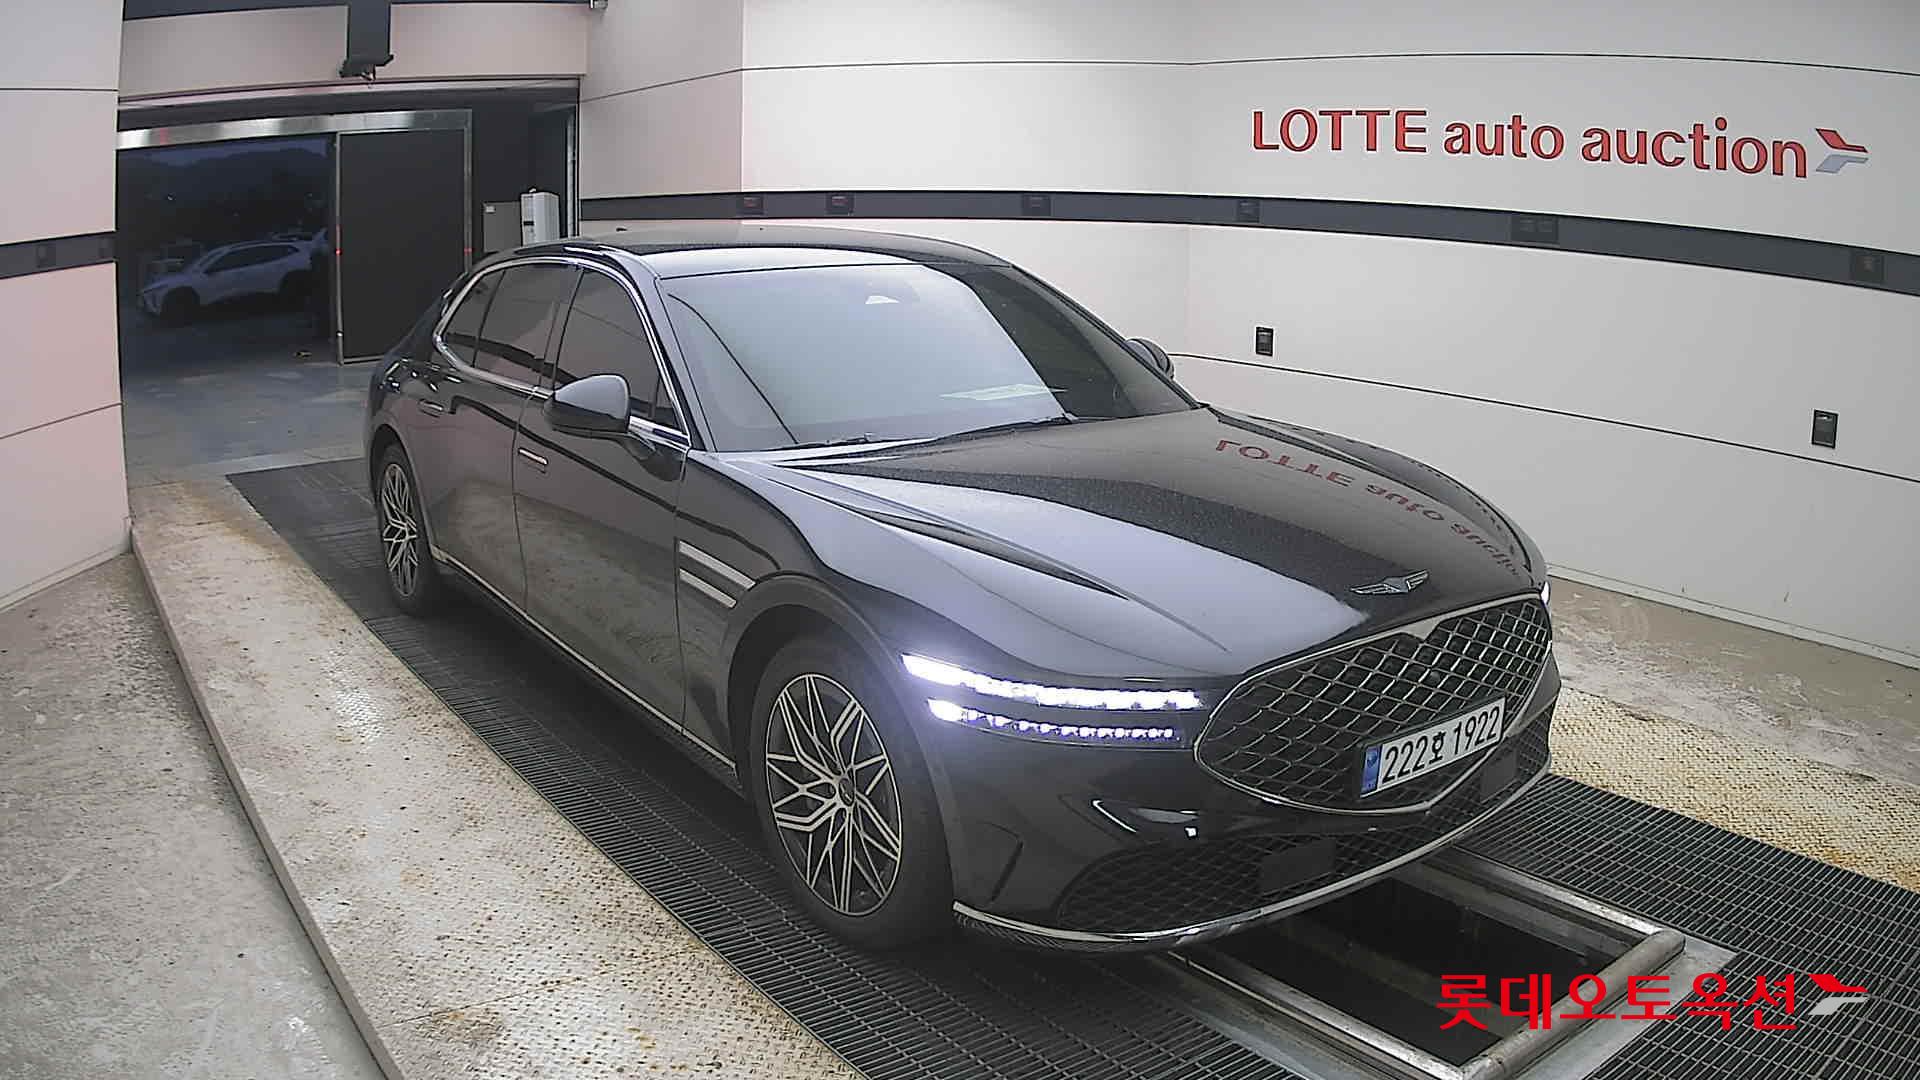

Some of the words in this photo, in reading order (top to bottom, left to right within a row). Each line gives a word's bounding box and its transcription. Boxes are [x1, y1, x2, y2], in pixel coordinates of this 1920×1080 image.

[1252, 109, 1427, 153] LOTTE
[1443, 115, 1565, 159] auto
[1580, 117, 1808, 178] auction
[1382, 731, 1447, 783] 222호
[1453, 706, 1501, 755] 1922
